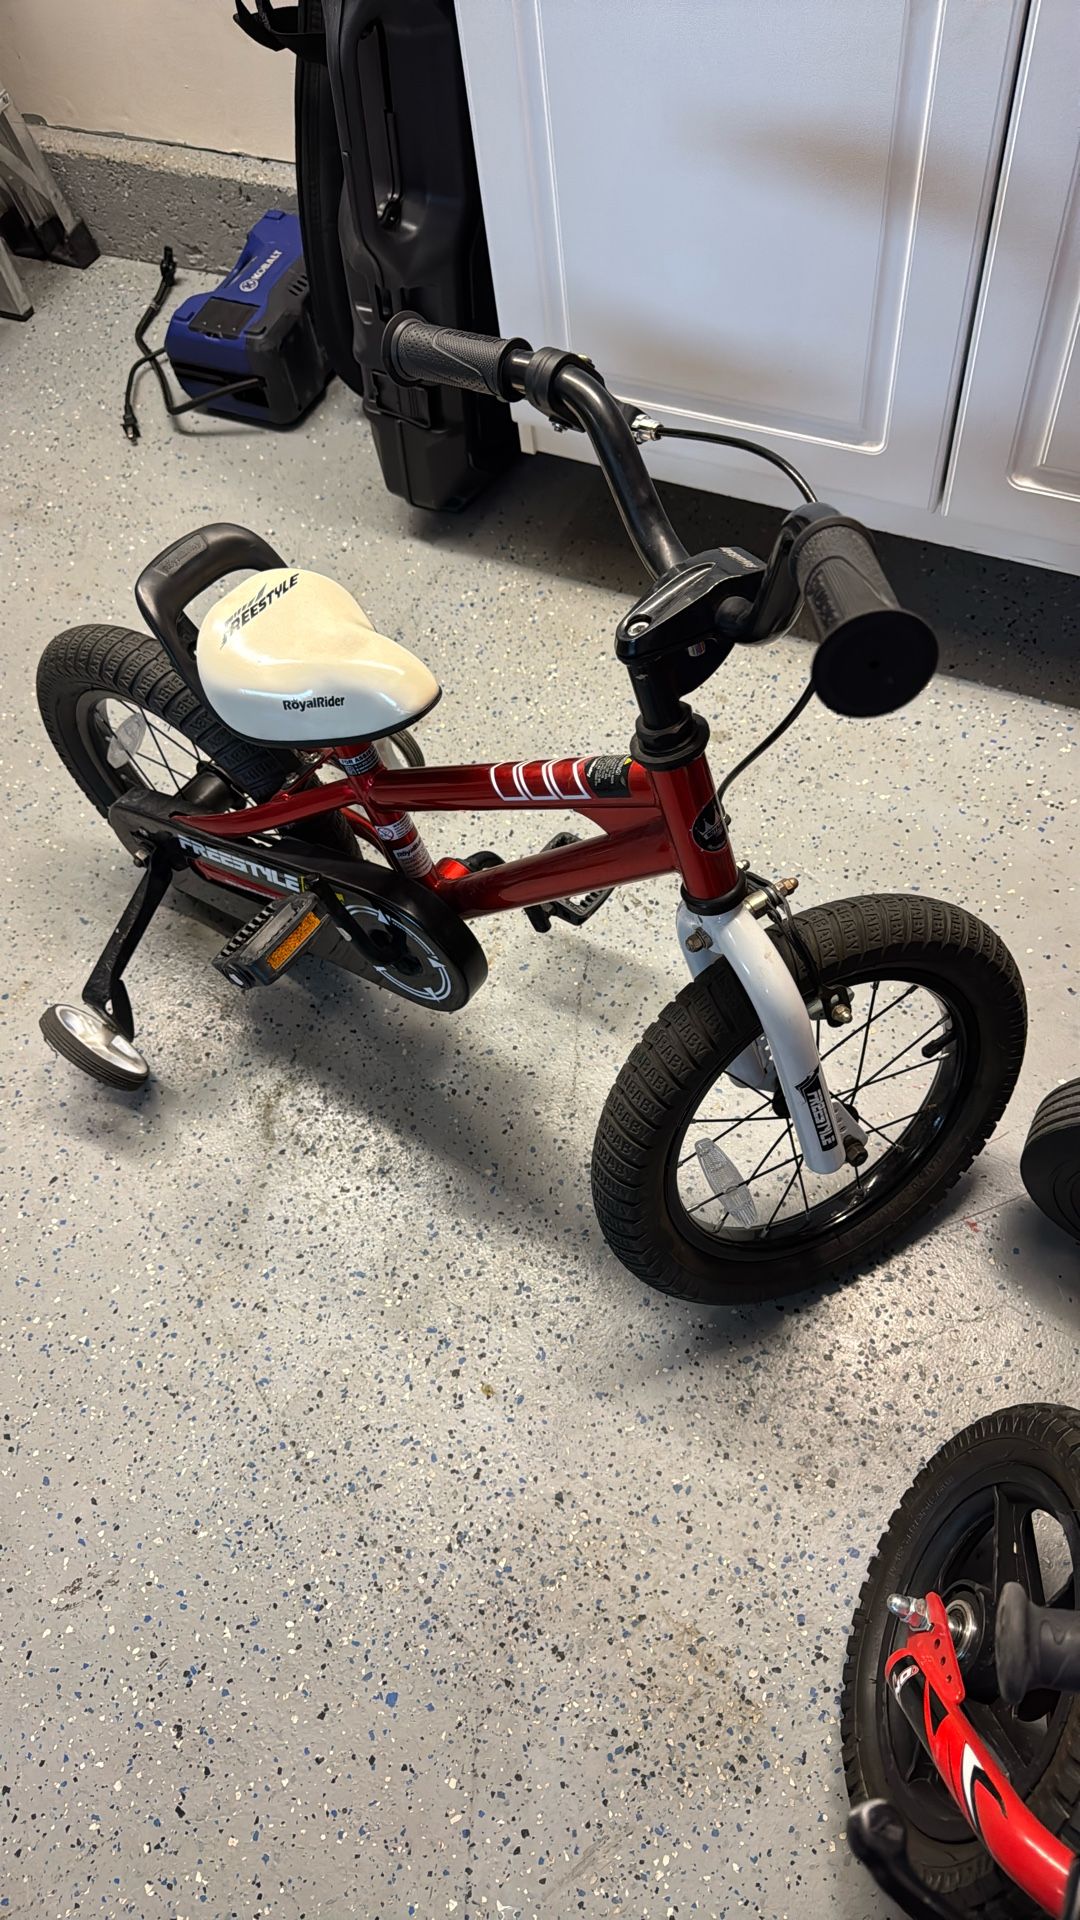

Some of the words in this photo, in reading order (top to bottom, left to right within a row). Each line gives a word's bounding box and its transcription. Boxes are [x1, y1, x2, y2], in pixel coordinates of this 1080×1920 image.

[251, 250, 282, 280] KOBALT
[282, 696, 345, 712] RoyalRider
[177, 833, 300, 893] FREESTYLE
[807, 1088, 836, 1147] FREESTYLE
